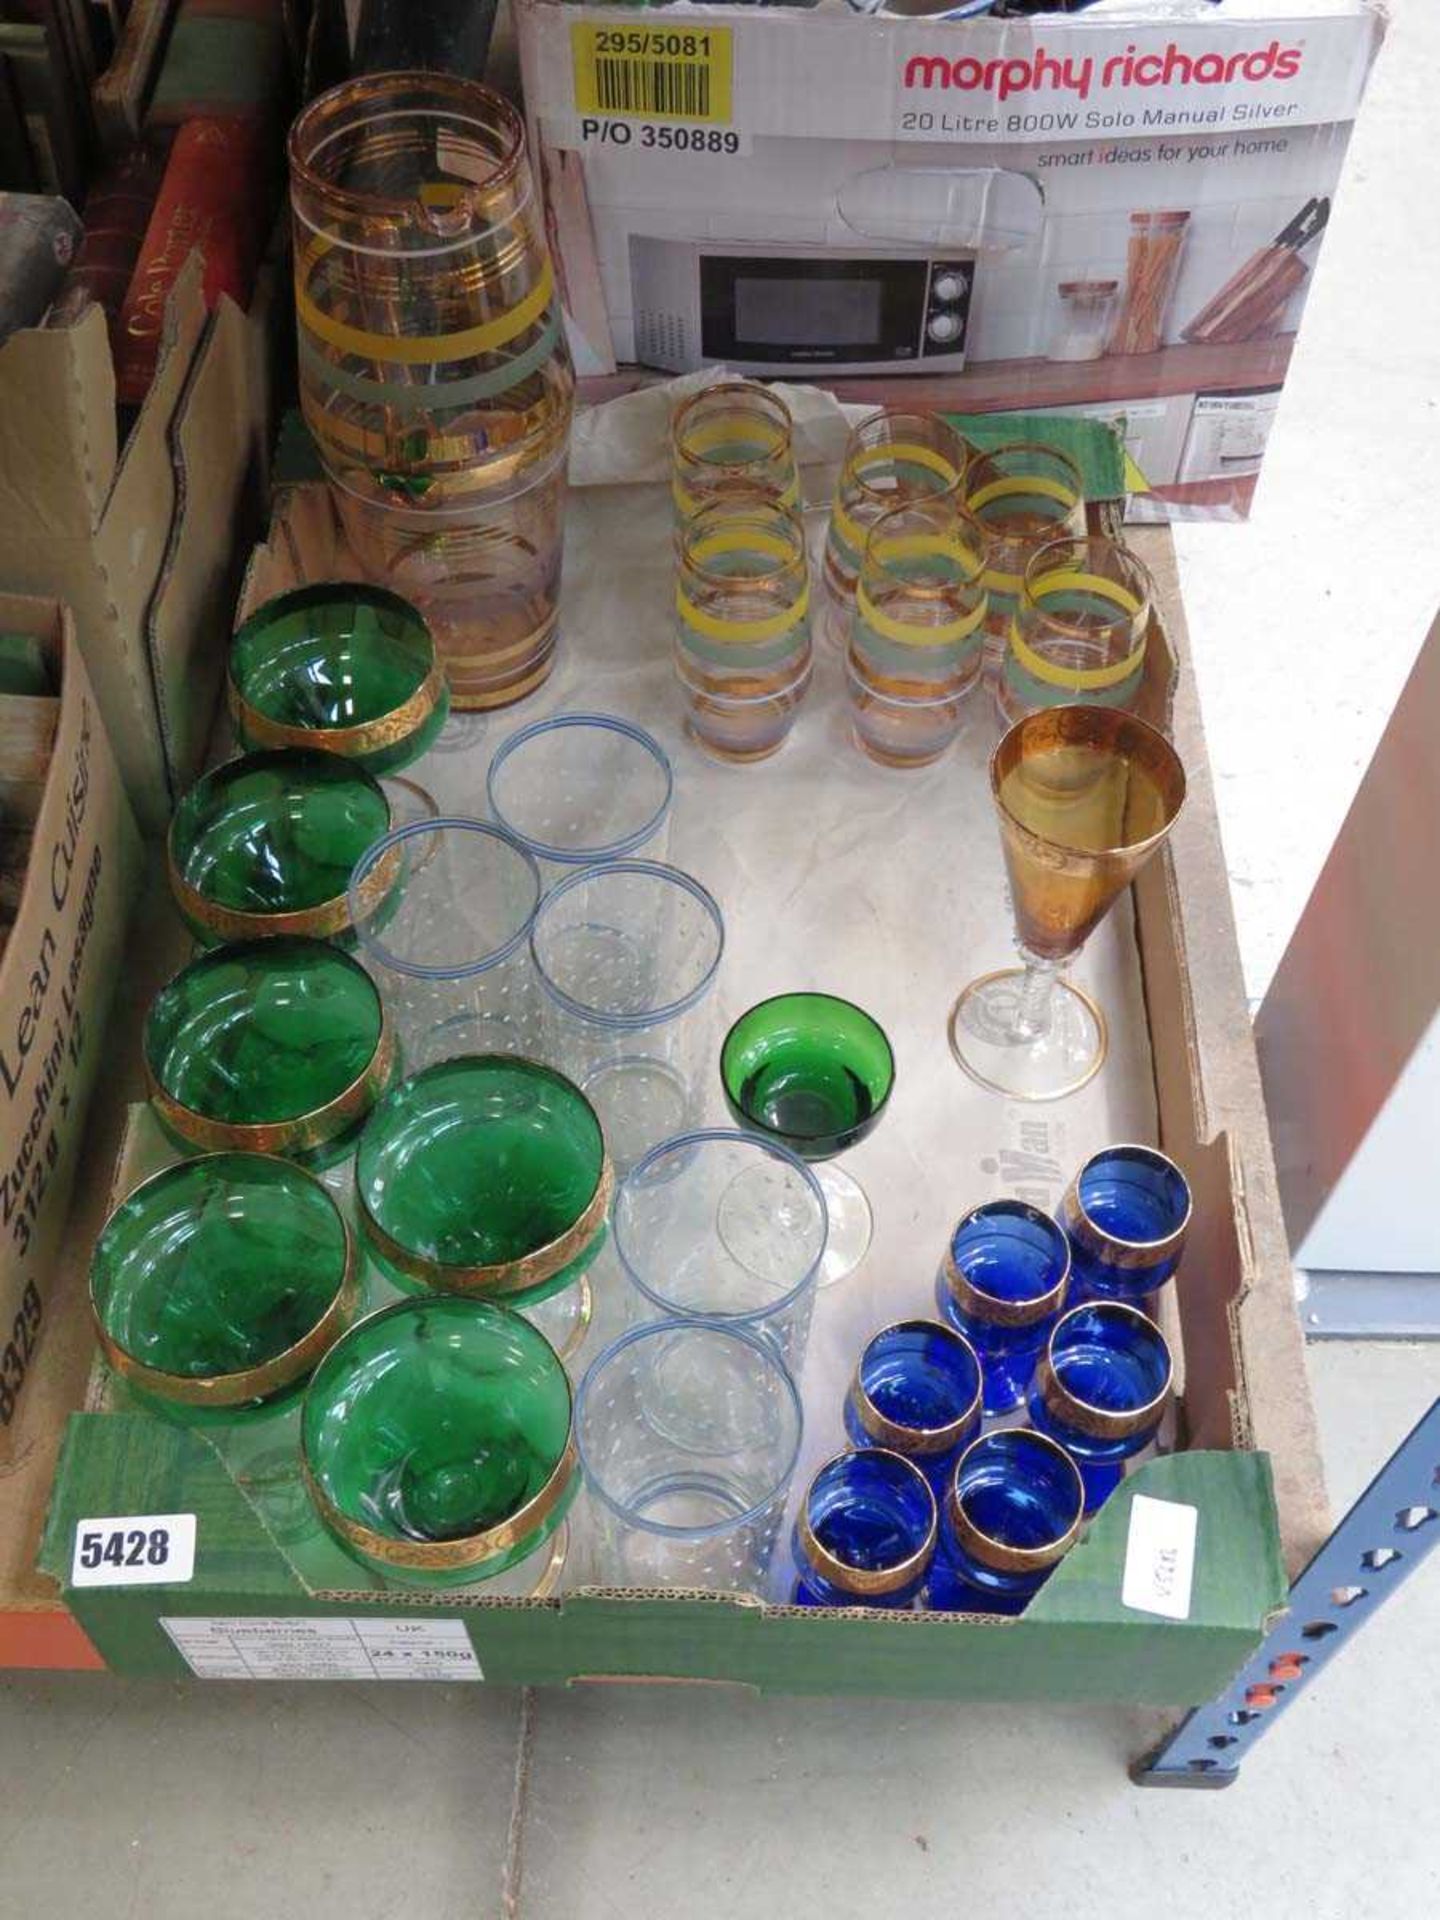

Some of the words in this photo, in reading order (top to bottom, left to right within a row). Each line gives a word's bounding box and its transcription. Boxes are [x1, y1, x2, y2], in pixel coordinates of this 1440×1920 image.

[595, 31, 711, 57] 295/5081
[904, 47, 1093, 101] morphy
[1102, 40, 1302, 87] richards
[902, 112, 934, 131] 20
[941, 111, 999, 132] Litre
[1006, 112, 1079, 132] 800W
[1085, 109, 1135, 130] Solo
[1142, 105, 1226, 127] Manual
[1231, 101, 1299, 122] Silver
[582, 118, 632, 145] P/O
[640, 124, 739, 154] 350889
[1037, 149, 1095, 168] smart
[1098, 145, 1152, 165] ideas
[1157, 143, 1182, 162] for
[1187, 143, 1230, 167] your
[1234, 137, 1289, 156] home
[0, 928, 56, 1100] Lean
[80, 1528, 169, 1569] 5428
